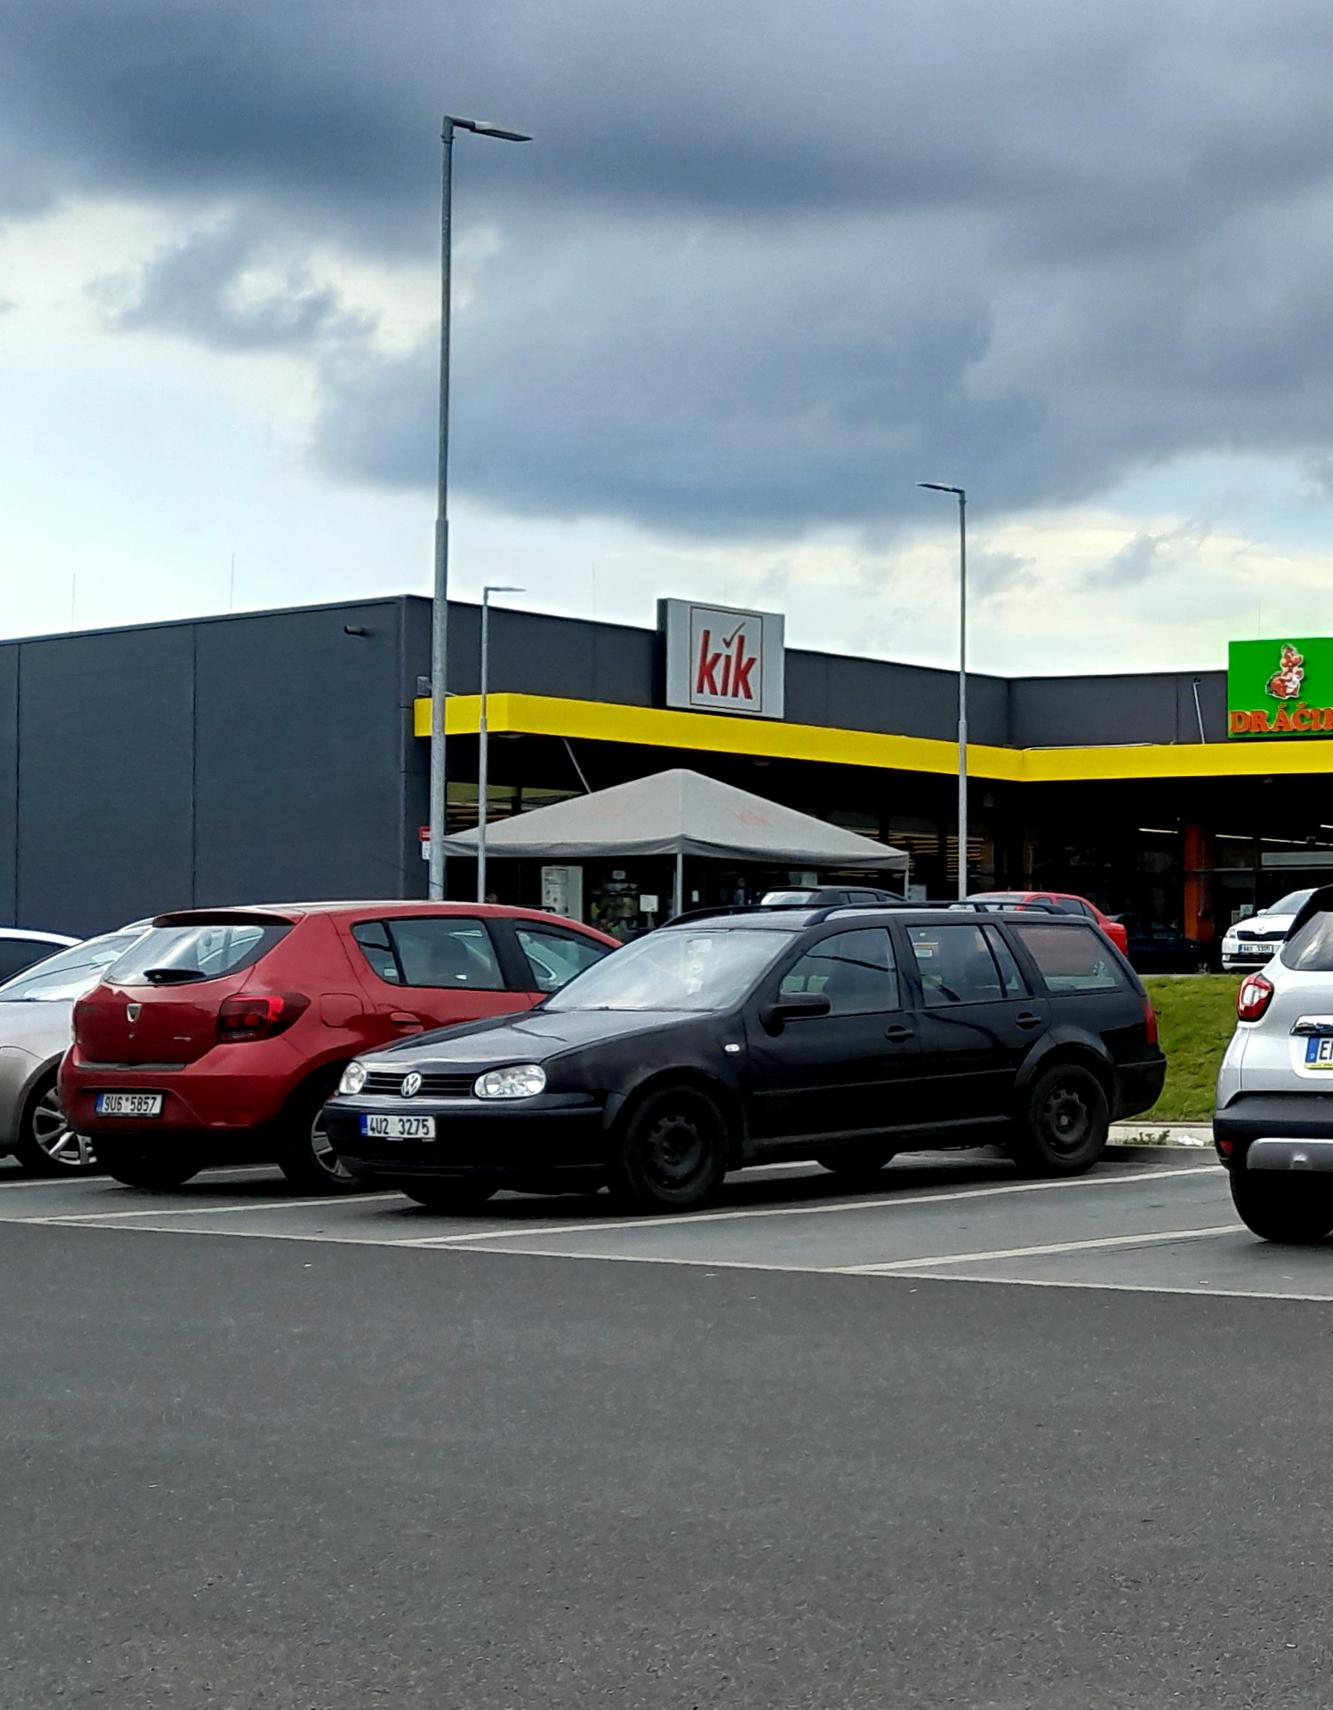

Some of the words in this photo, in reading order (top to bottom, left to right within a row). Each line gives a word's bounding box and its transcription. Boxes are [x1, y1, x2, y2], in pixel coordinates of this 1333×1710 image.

[697, 623, 757, 700] kik
[104, 1096, 124, 1111] 9U6
[130, 1096, 157, 1112] 5857
[370, 1117, 389, 1135] 4U2
[398, 1118, 430, 1136] 3275
